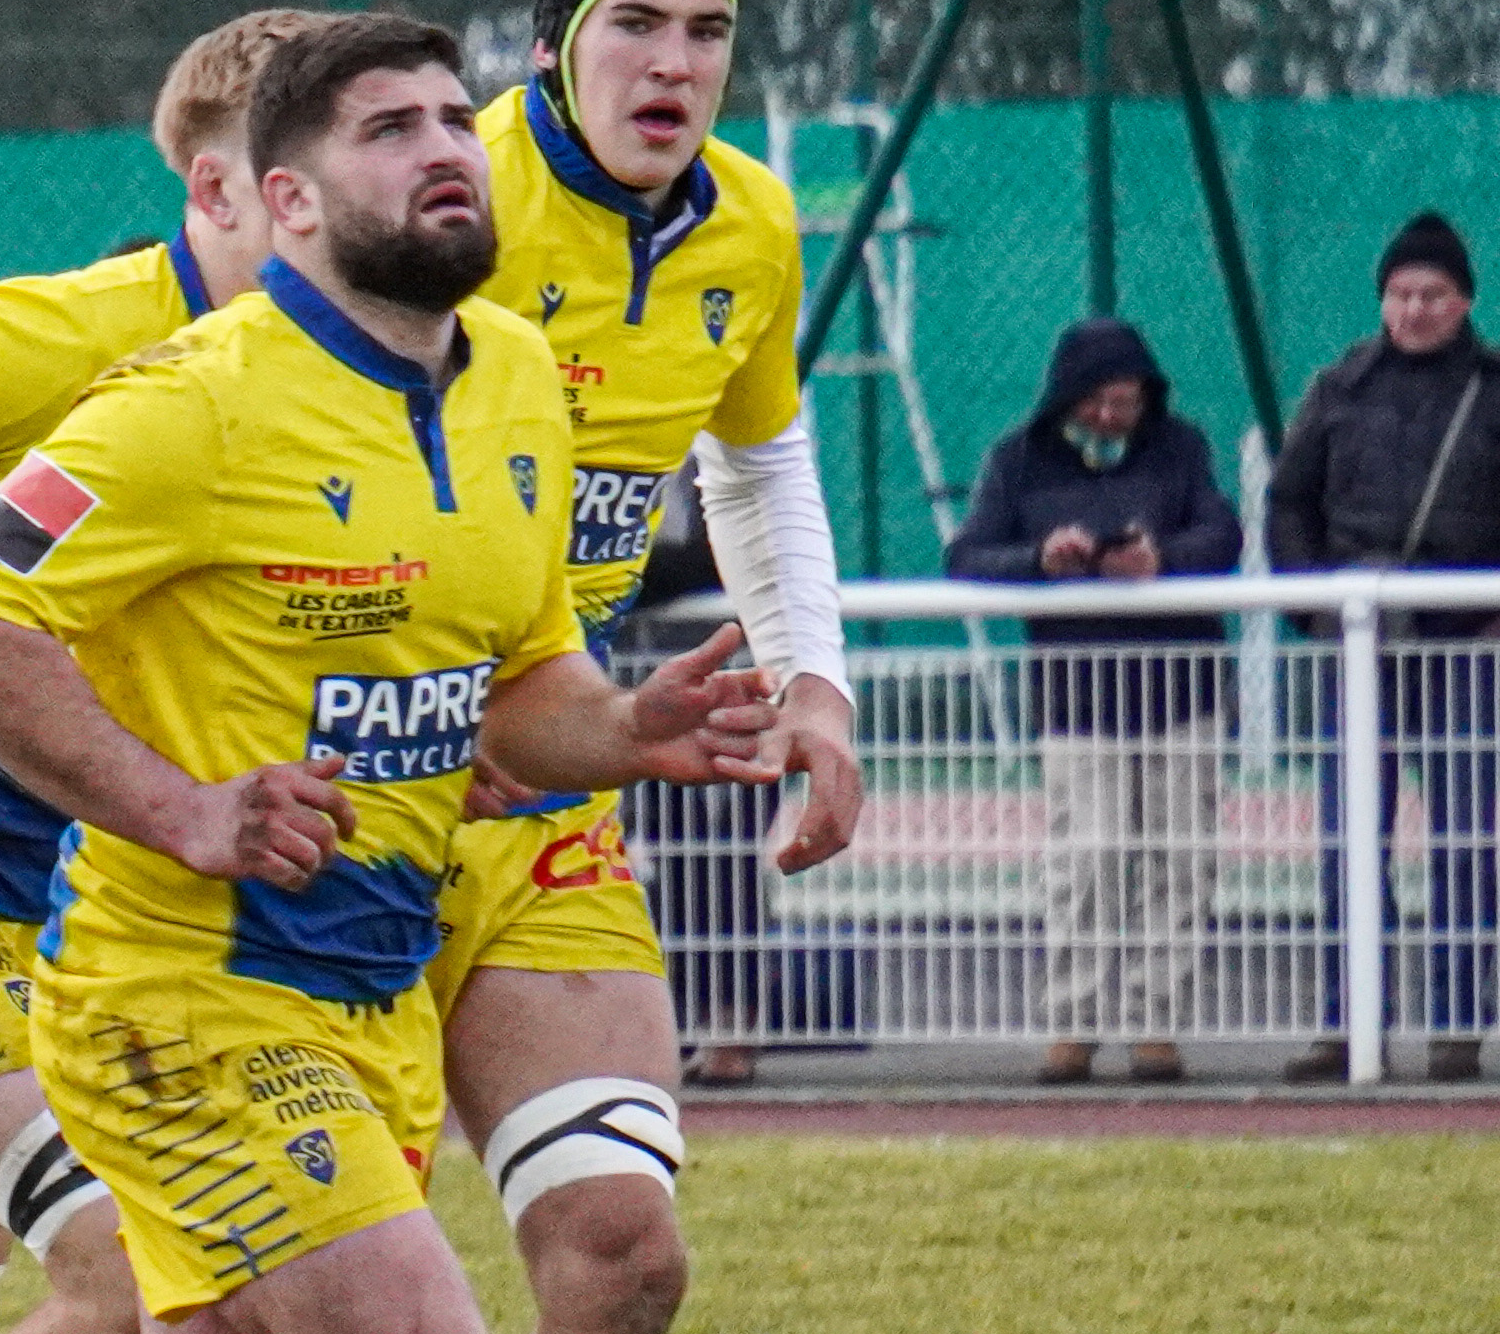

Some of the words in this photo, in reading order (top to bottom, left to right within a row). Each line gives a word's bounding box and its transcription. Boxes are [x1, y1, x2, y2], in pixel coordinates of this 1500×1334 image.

[261, 552, 428, 587] amerin
[286, 591, 326, 611] LES
[316, 664, 494, 739] PAPRE
[309, 738, 474, 779] RECYCLA
